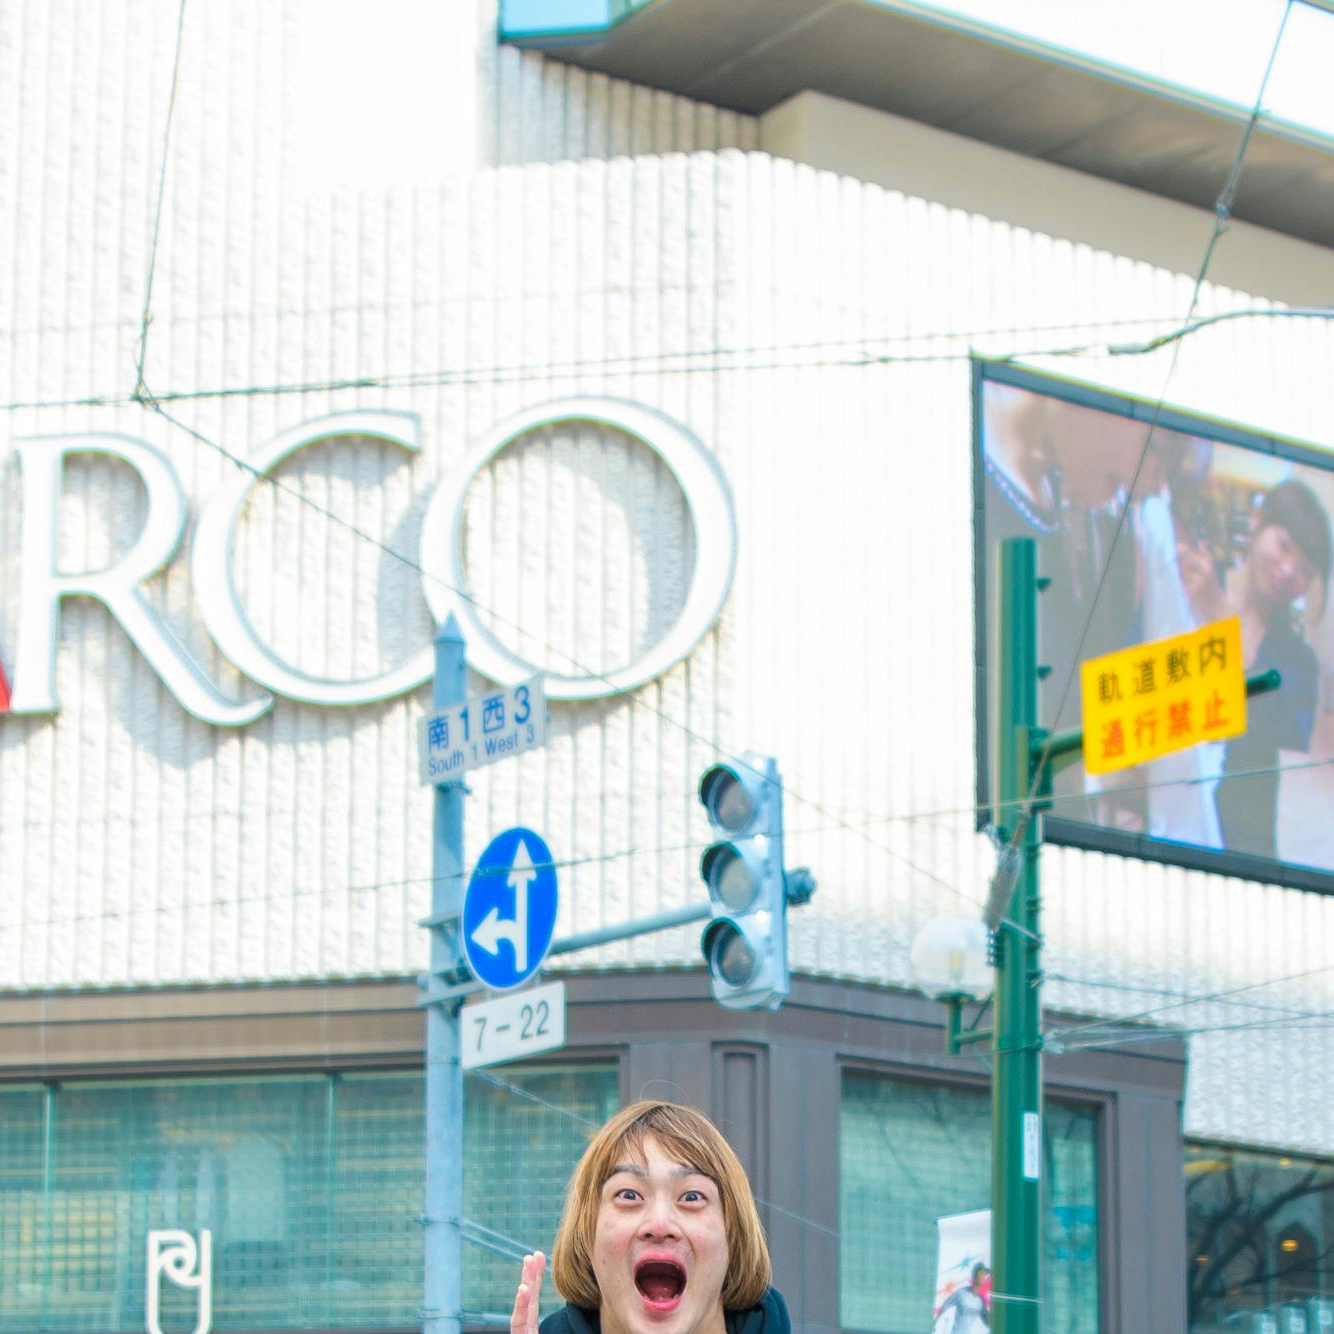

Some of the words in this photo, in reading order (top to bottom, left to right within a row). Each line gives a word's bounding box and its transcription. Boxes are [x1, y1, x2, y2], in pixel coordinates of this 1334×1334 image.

[1098, 635, 1227, 704] 軌道敷内
[428, 749, 465, 777] South
[471, 742, 478, 761] 1
[485, 729, 519, 756] West
[526, 723, 535, 743] 3
[1101, 689, 1229, 759] 通行禁止
